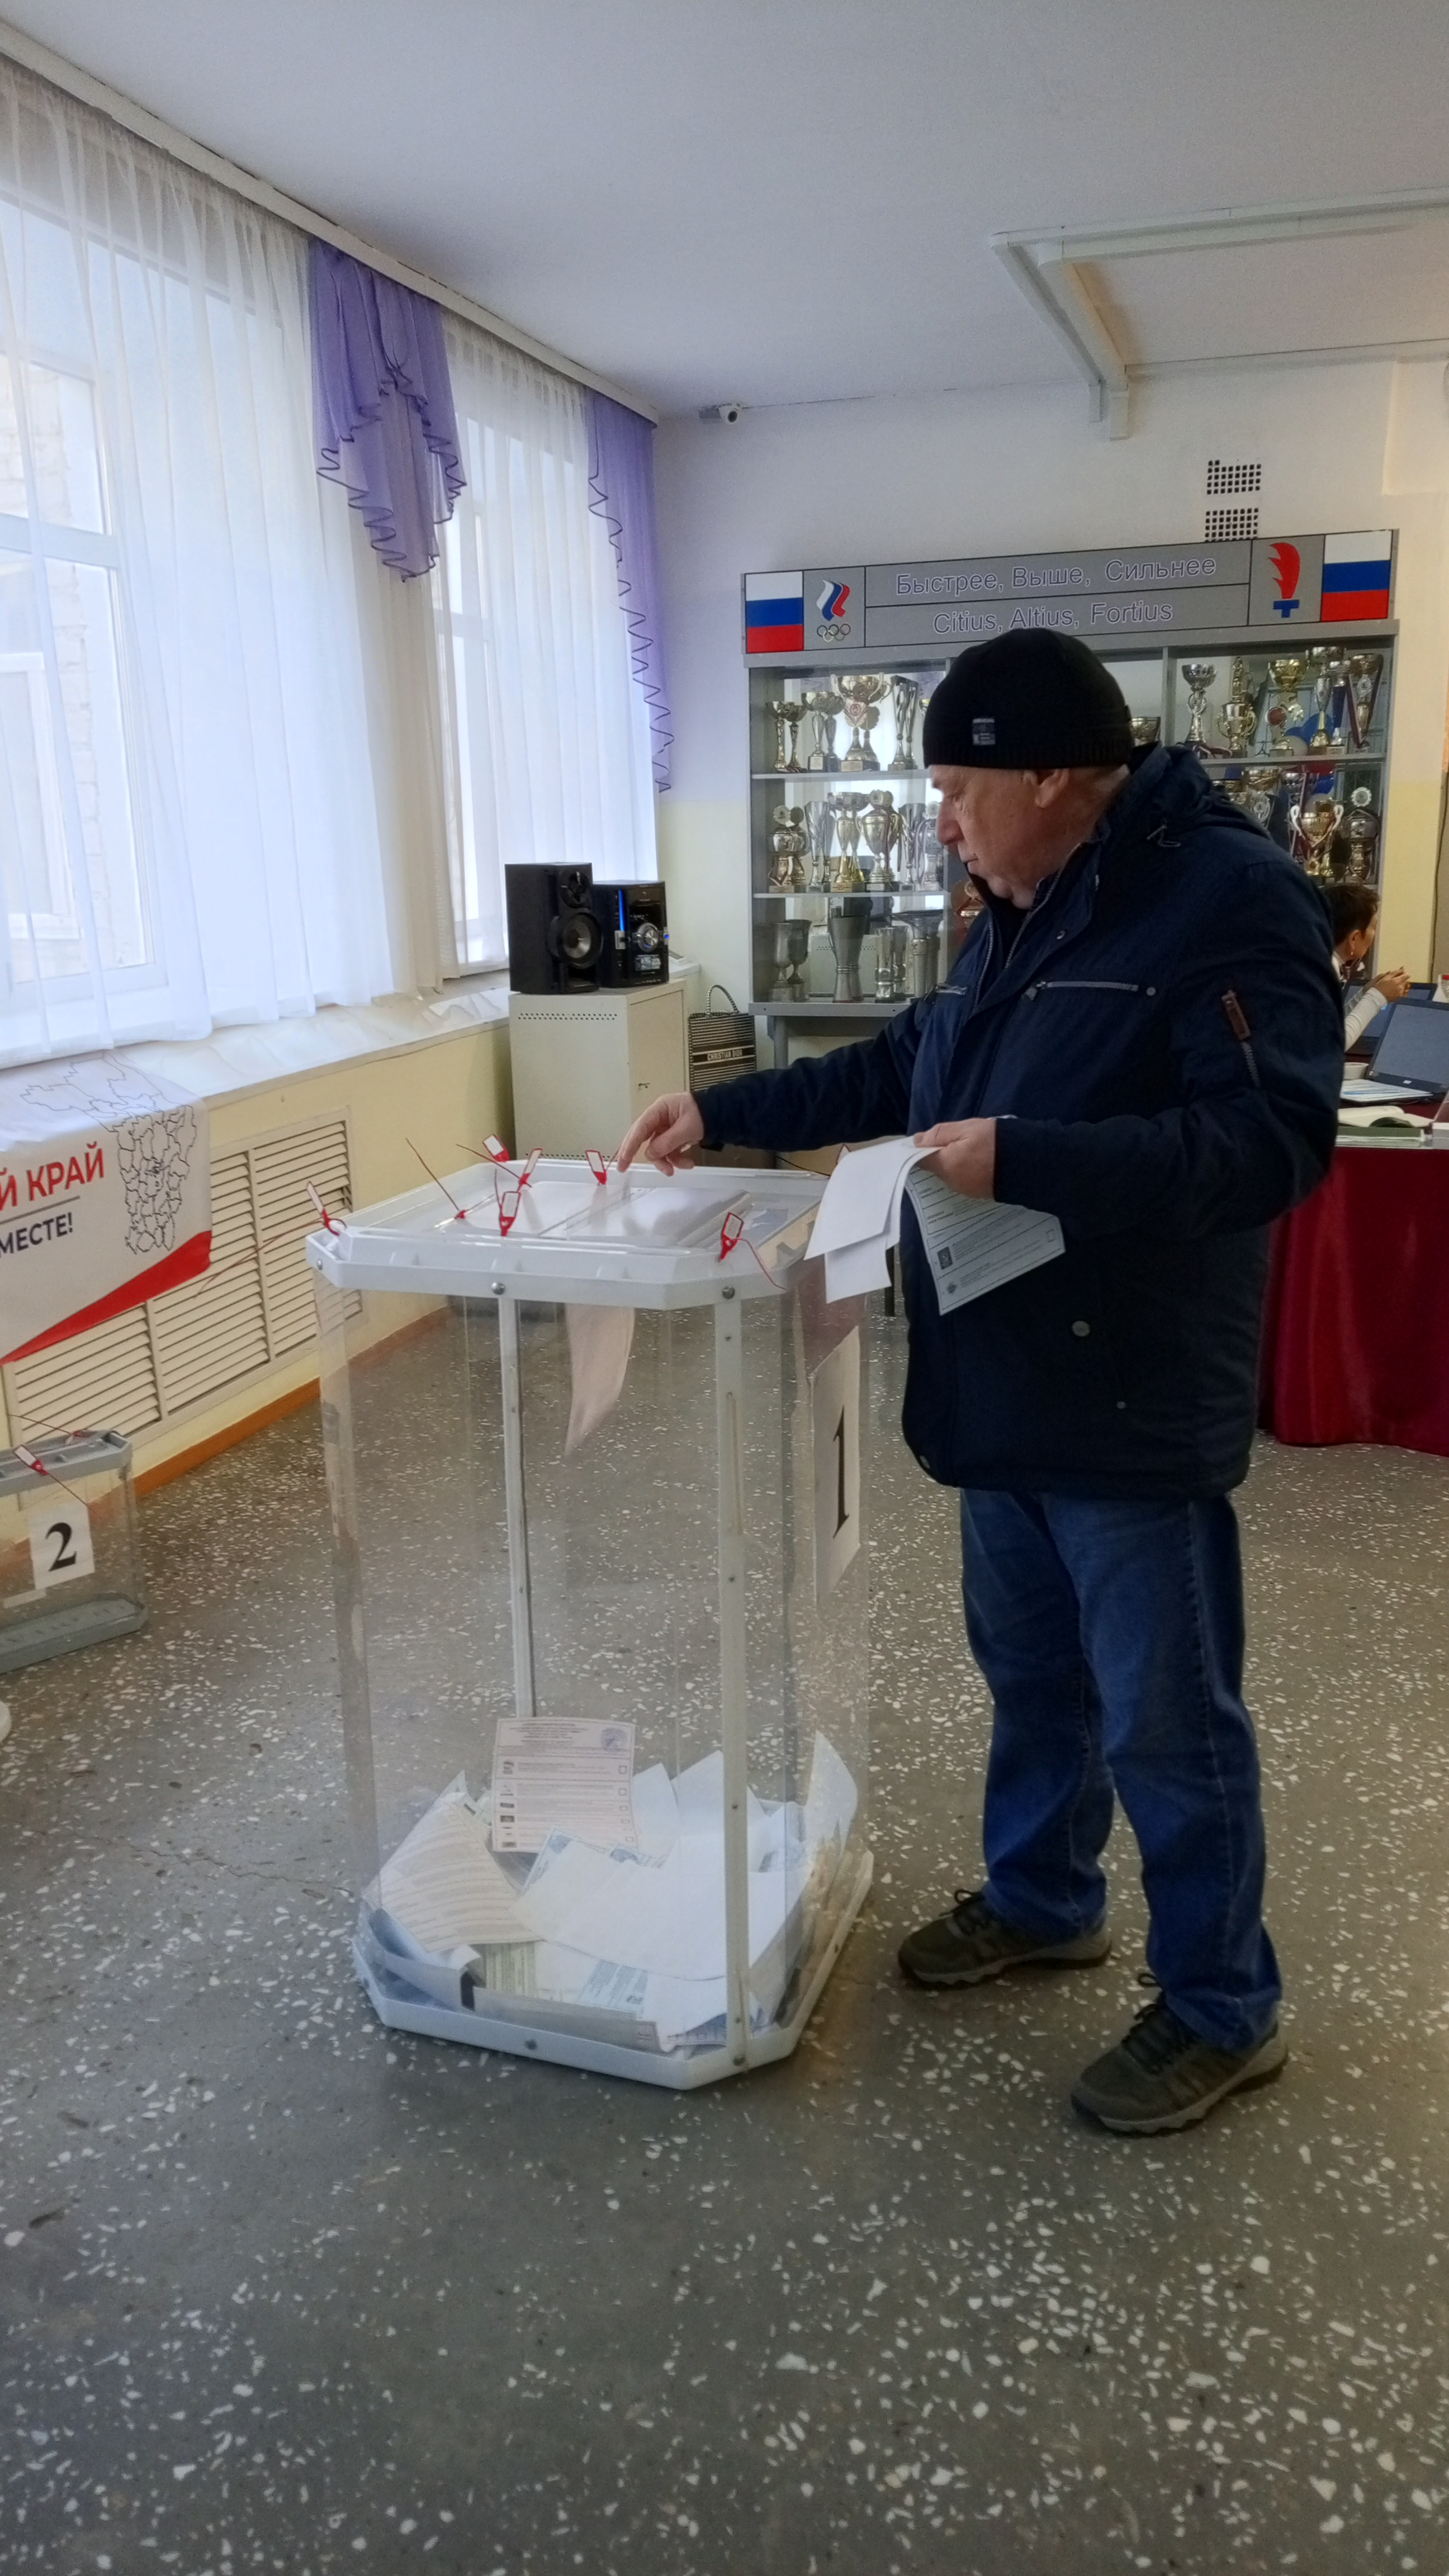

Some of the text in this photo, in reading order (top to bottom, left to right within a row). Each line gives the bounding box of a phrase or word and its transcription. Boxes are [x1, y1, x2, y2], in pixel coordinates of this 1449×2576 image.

[896, 558, 1216, 597] Быстрее, Выше, Сильнее
[933, 600, 1173, 634] Citius, Altius, Fortius
[26, 1140, 105, 1201] КРАЙ
[832, 1403, 850, 1540] 1
[45, 1522, 78, 1572] 2
